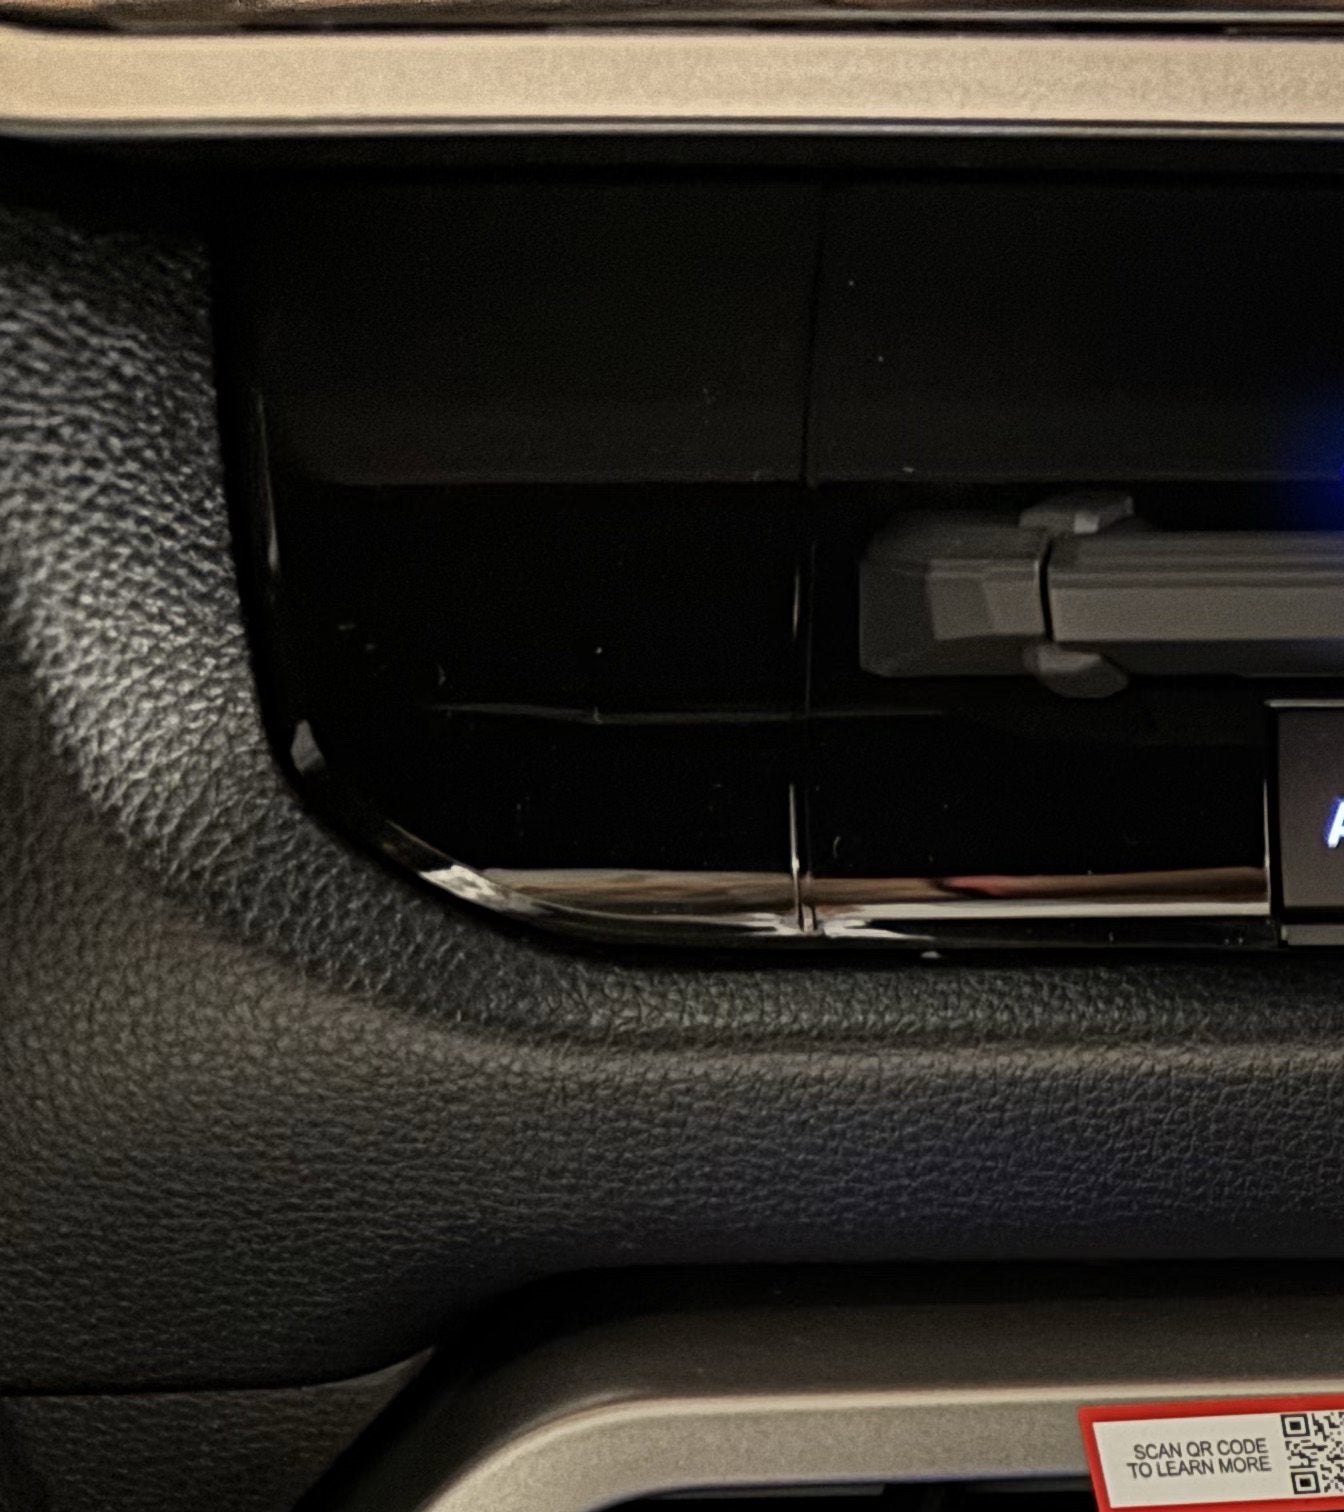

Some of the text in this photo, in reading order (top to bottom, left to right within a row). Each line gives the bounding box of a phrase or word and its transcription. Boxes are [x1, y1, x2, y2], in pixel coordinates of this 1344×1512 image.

[1134, 1436, 1269, 1460] SCAN QR CODE
[1127, 1454, 1272, 1479] TO LEARN MORE
